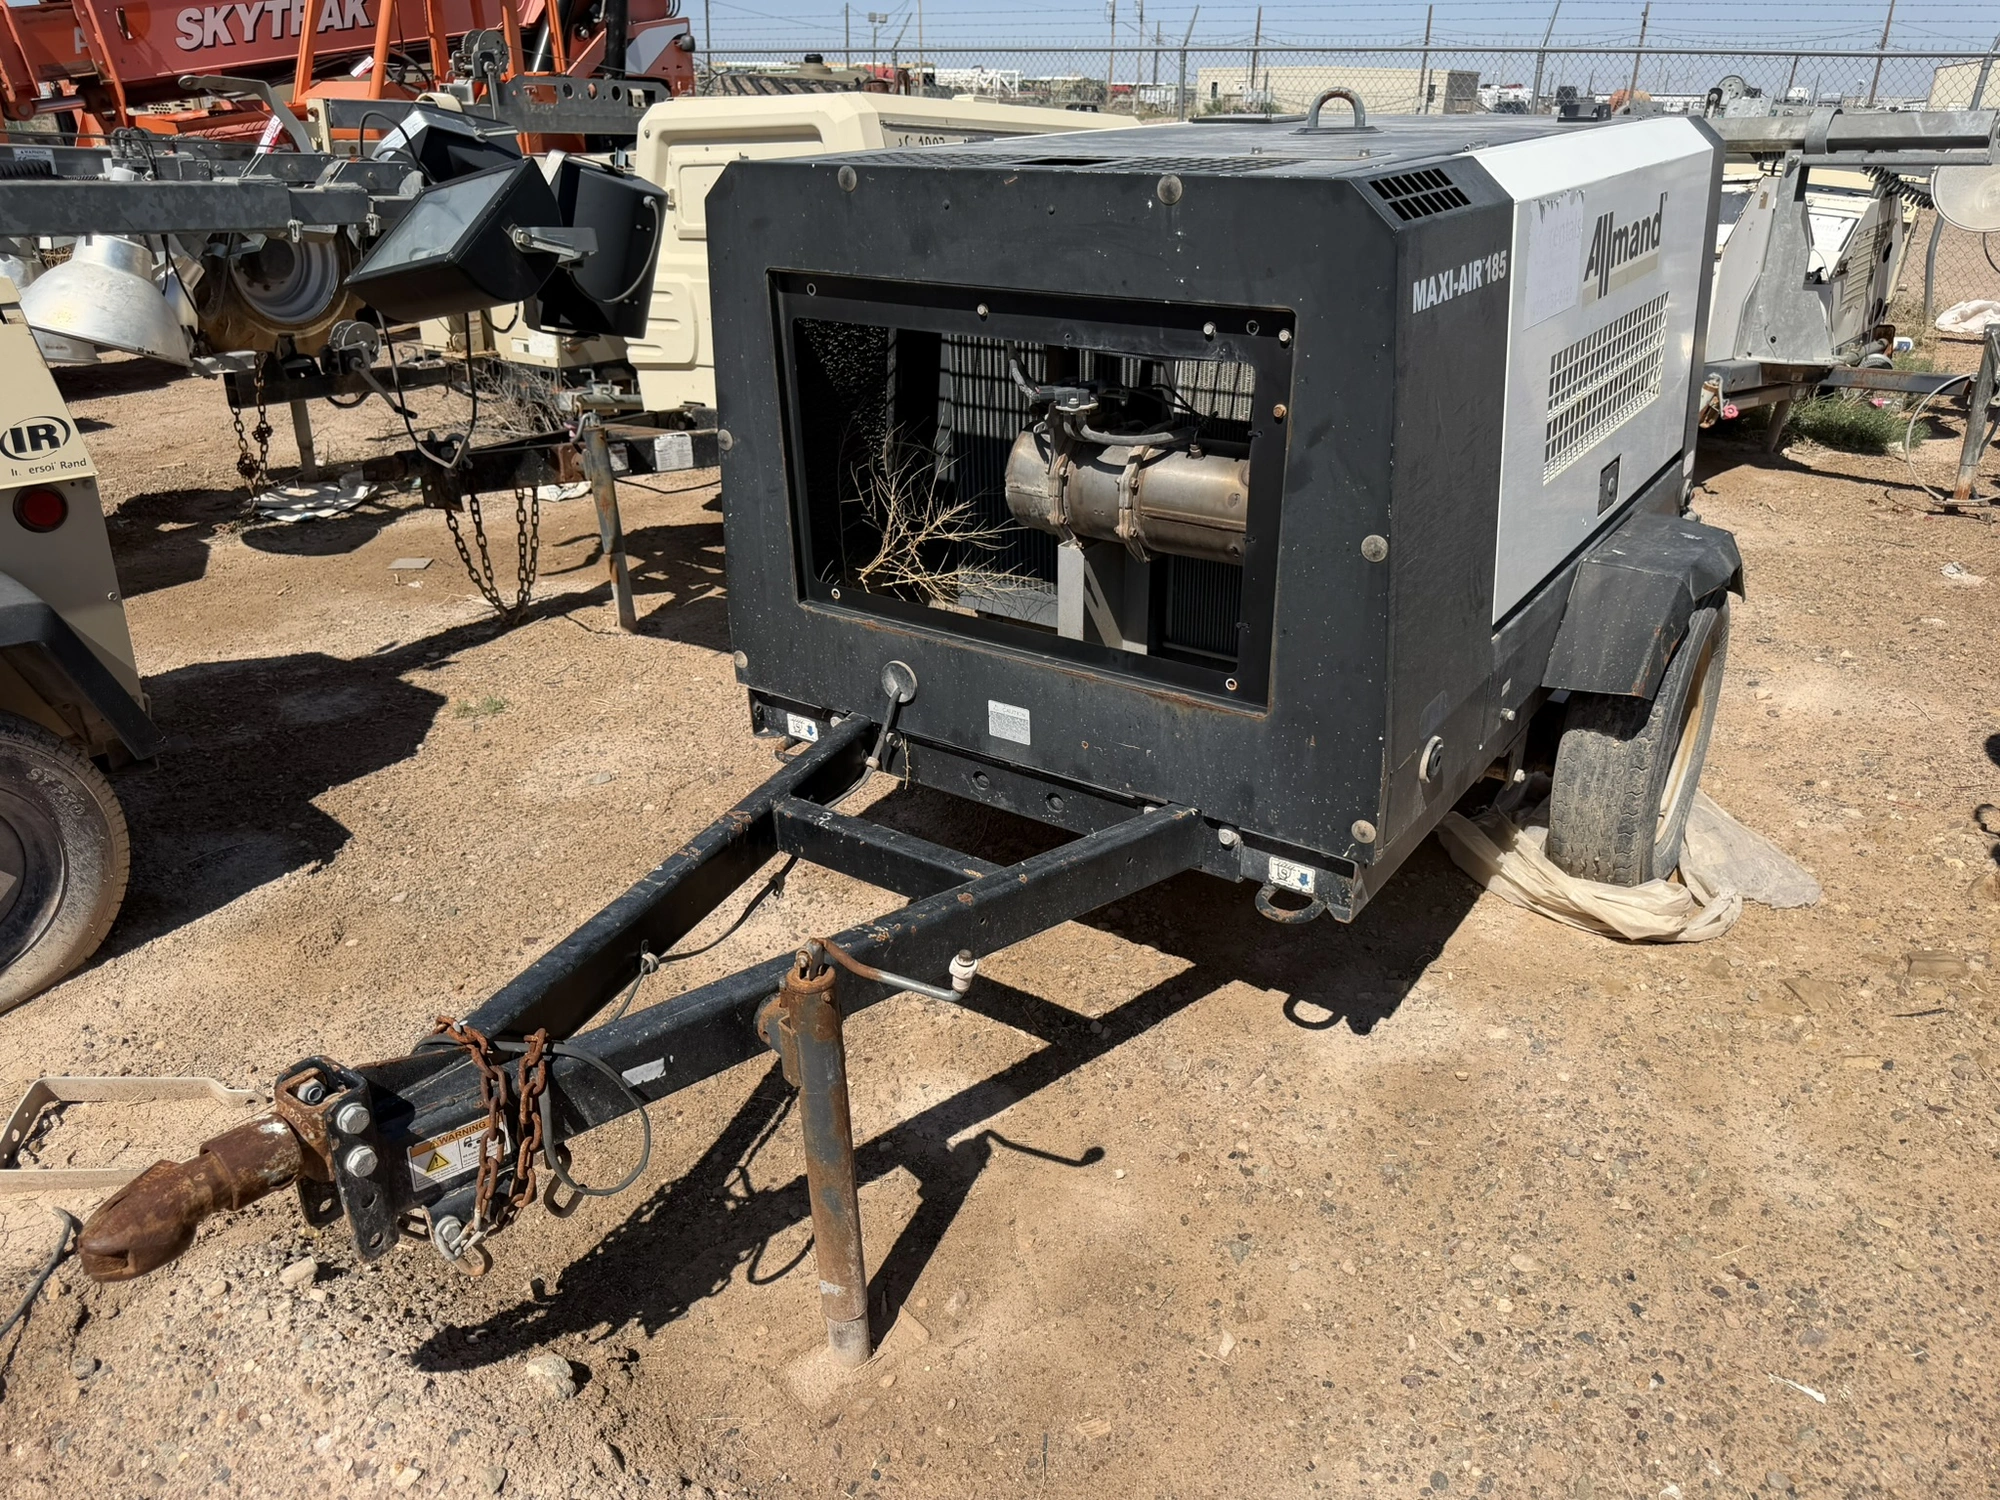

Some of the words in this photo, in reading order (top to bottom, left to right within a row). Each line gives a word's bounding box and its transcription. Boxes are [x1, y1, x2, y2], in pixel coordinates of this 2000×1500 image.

[175, 0, 372, 50] SKYTRAK
[1583, 193, 1666, 300] Allmand
[1412, 259, 1483, 314] MAXI-AIR
[1485, 250, 1507, 284] 185
[9, 424, 60, 453] IR
[60, 458, 87, 470] Rand
[439, 1121, 487, 1145] WARNING
